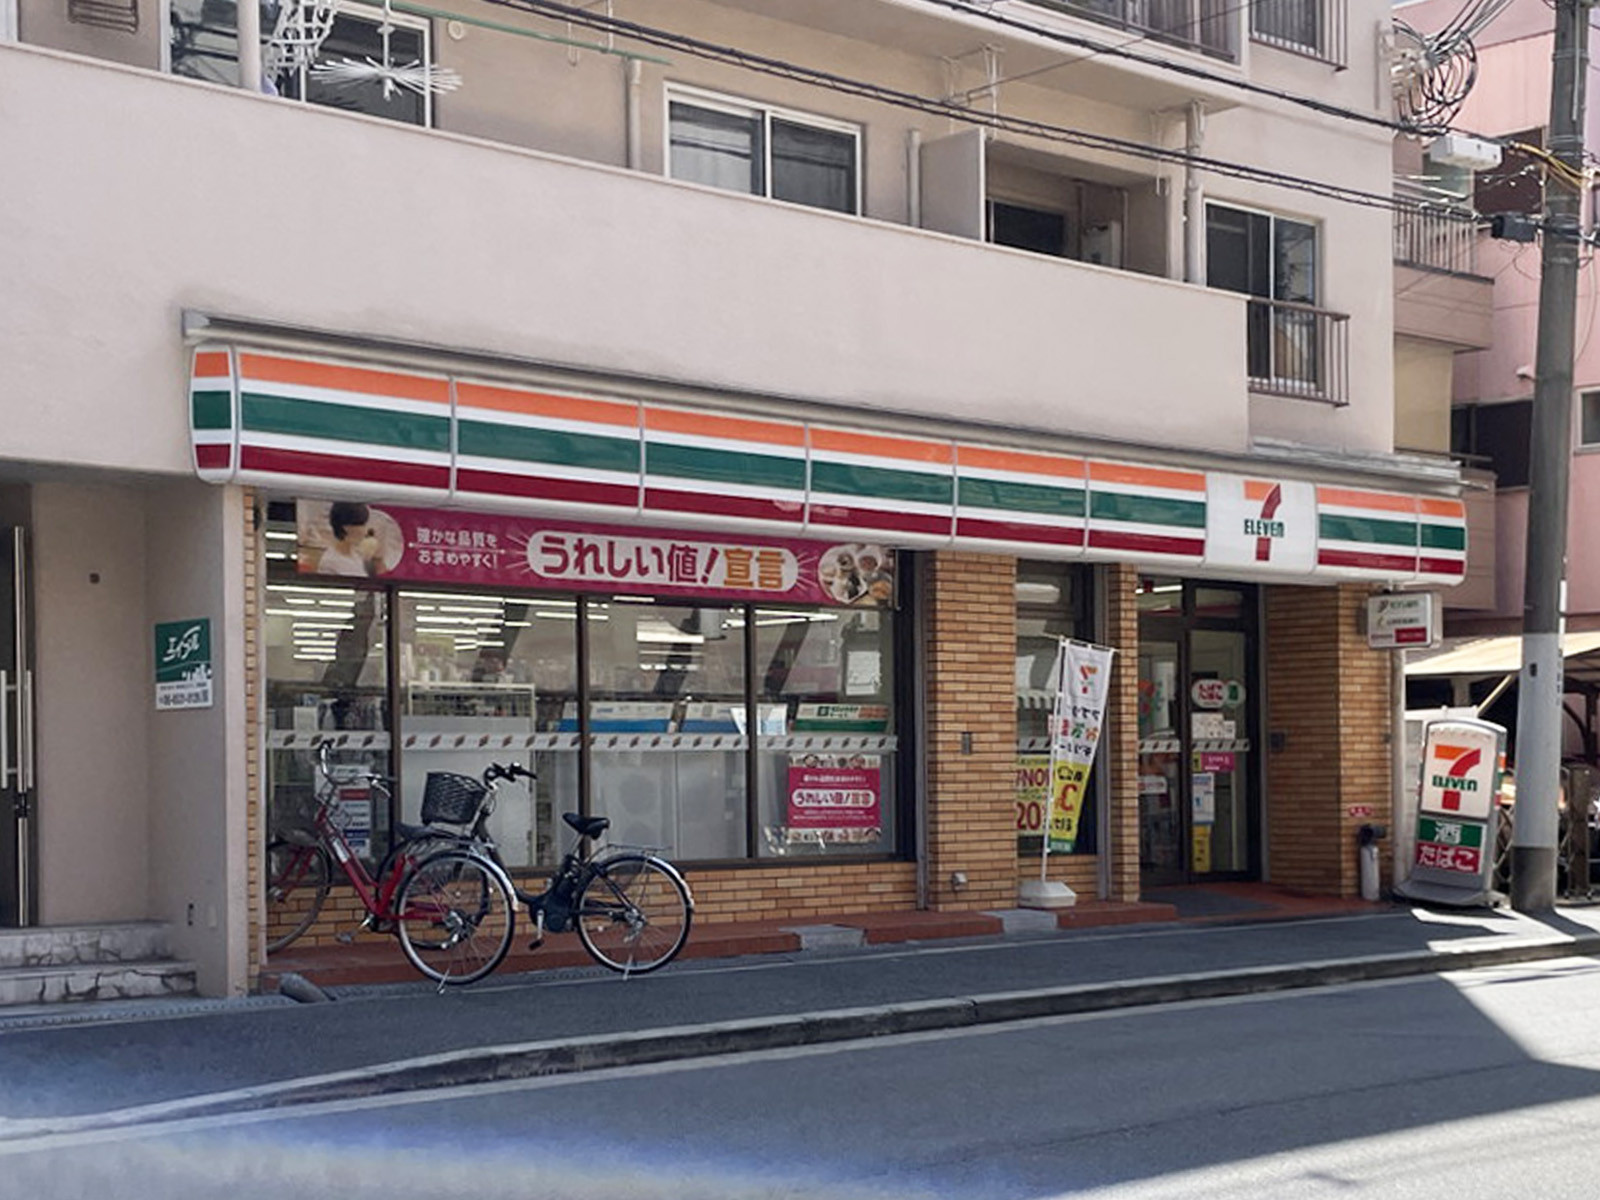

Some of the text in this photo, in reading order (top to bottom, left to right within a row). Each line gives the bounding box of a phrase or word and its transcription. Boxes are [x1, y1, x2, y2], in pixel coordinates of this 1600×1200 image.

[417, 527, 497, 549] 確かな品質を
[1434, 820, 1462, 845] 酒
[1419, 845, 1475, 872] たばこ
